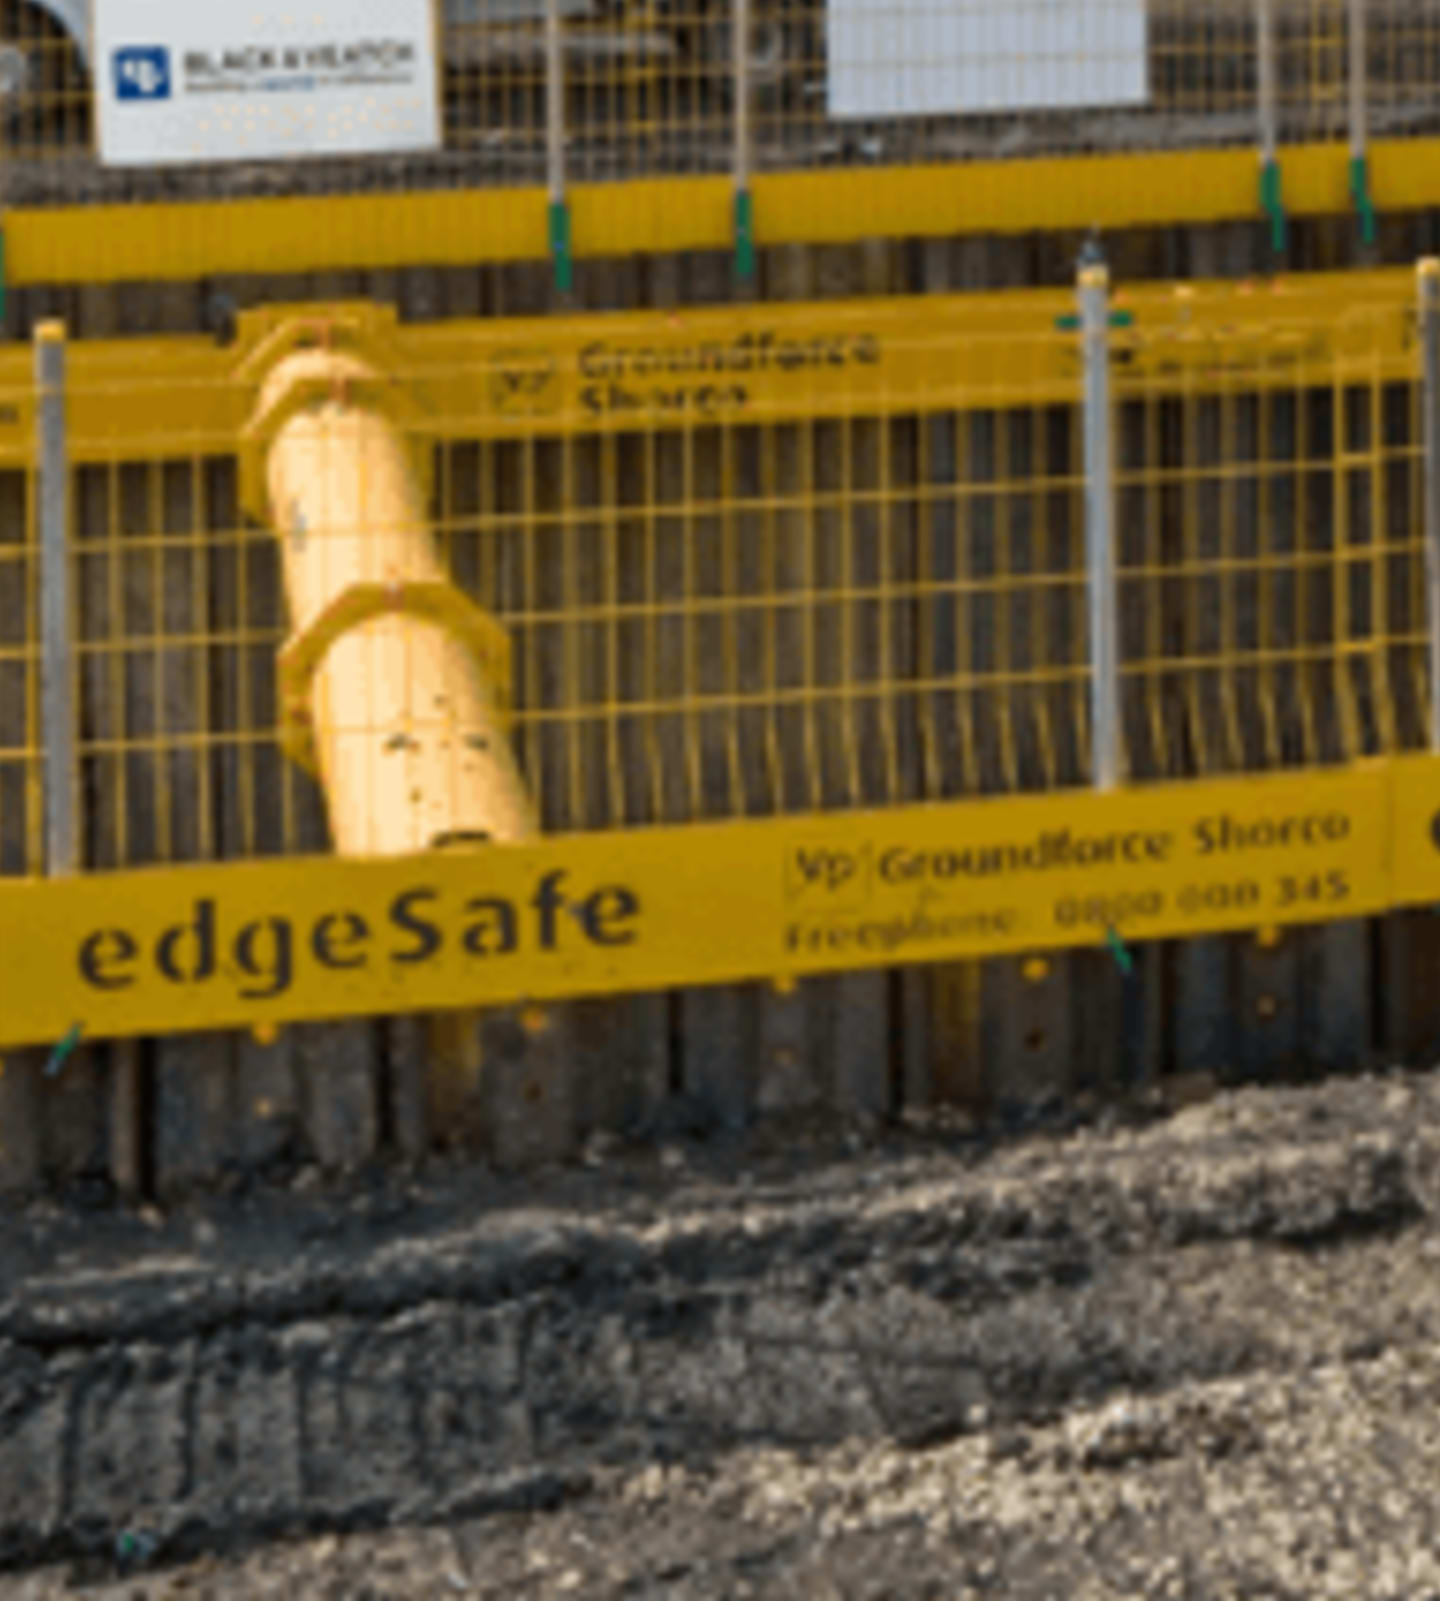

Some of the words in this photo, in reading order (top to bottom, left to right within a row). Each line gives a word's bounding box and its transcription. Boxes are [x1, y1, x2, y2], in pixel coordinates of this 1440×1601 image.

[184, 45, 275, 77] BLACK
[304, 38, 415, 70] VEATCH
[879, 827, 1172, 884] Groundforce
[1194, 811, 1349, 855] Shorco
[1275, 873, 1349, 908] 345
[78, 870, 639, 1001] edgeSafe
